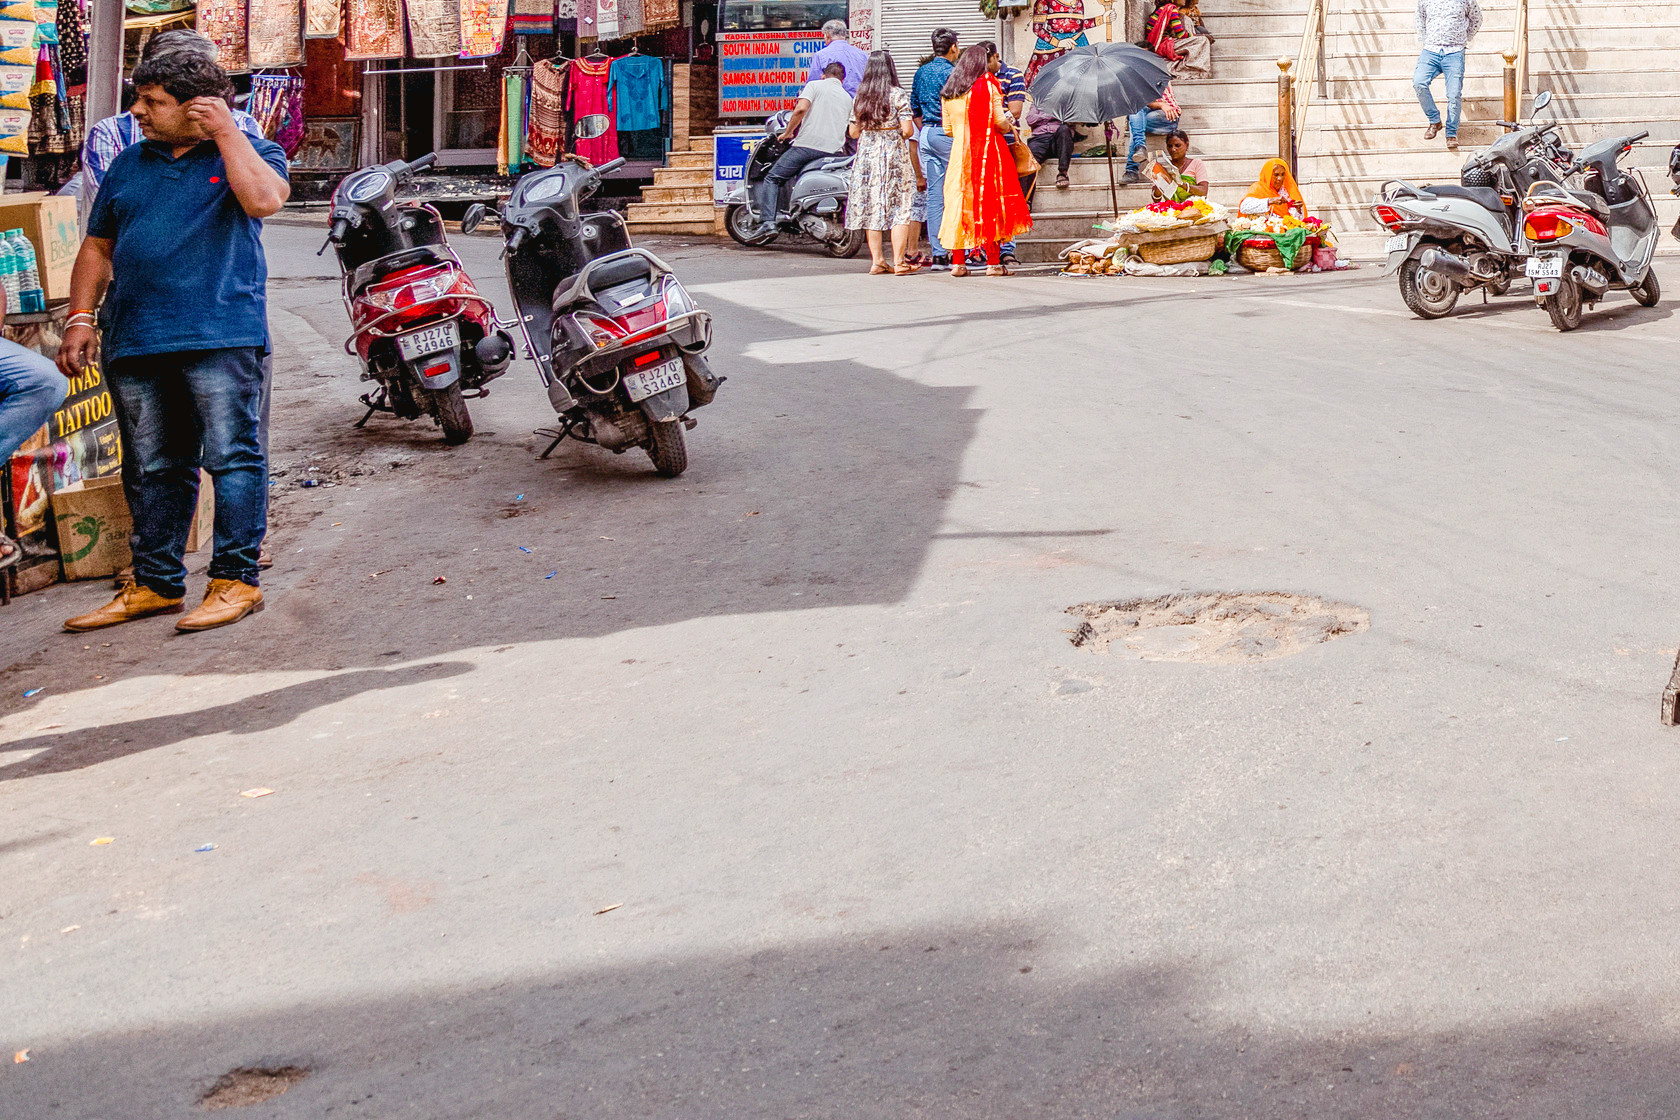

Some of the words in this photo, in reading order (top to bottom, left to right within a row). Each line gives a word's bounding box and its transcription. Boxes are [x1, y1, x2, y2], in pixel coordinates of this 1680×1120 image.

[723, 43, 750, 56] SOUTH
[752, 42, 780, 55] INDIAN
[723, 73, 756, 85] SAMOSA
[758, 72, 796, 84] KACHORI
[723, 100, 737, 112] ALOO
[738, 100, 761, 111] PARATHA
[763, 99, 782, 111] CHOLA
[719, 165, 743, 179] चाय
[643, 373, 681, 395] S3449
[55, 391, 112, 438] TATTOO
